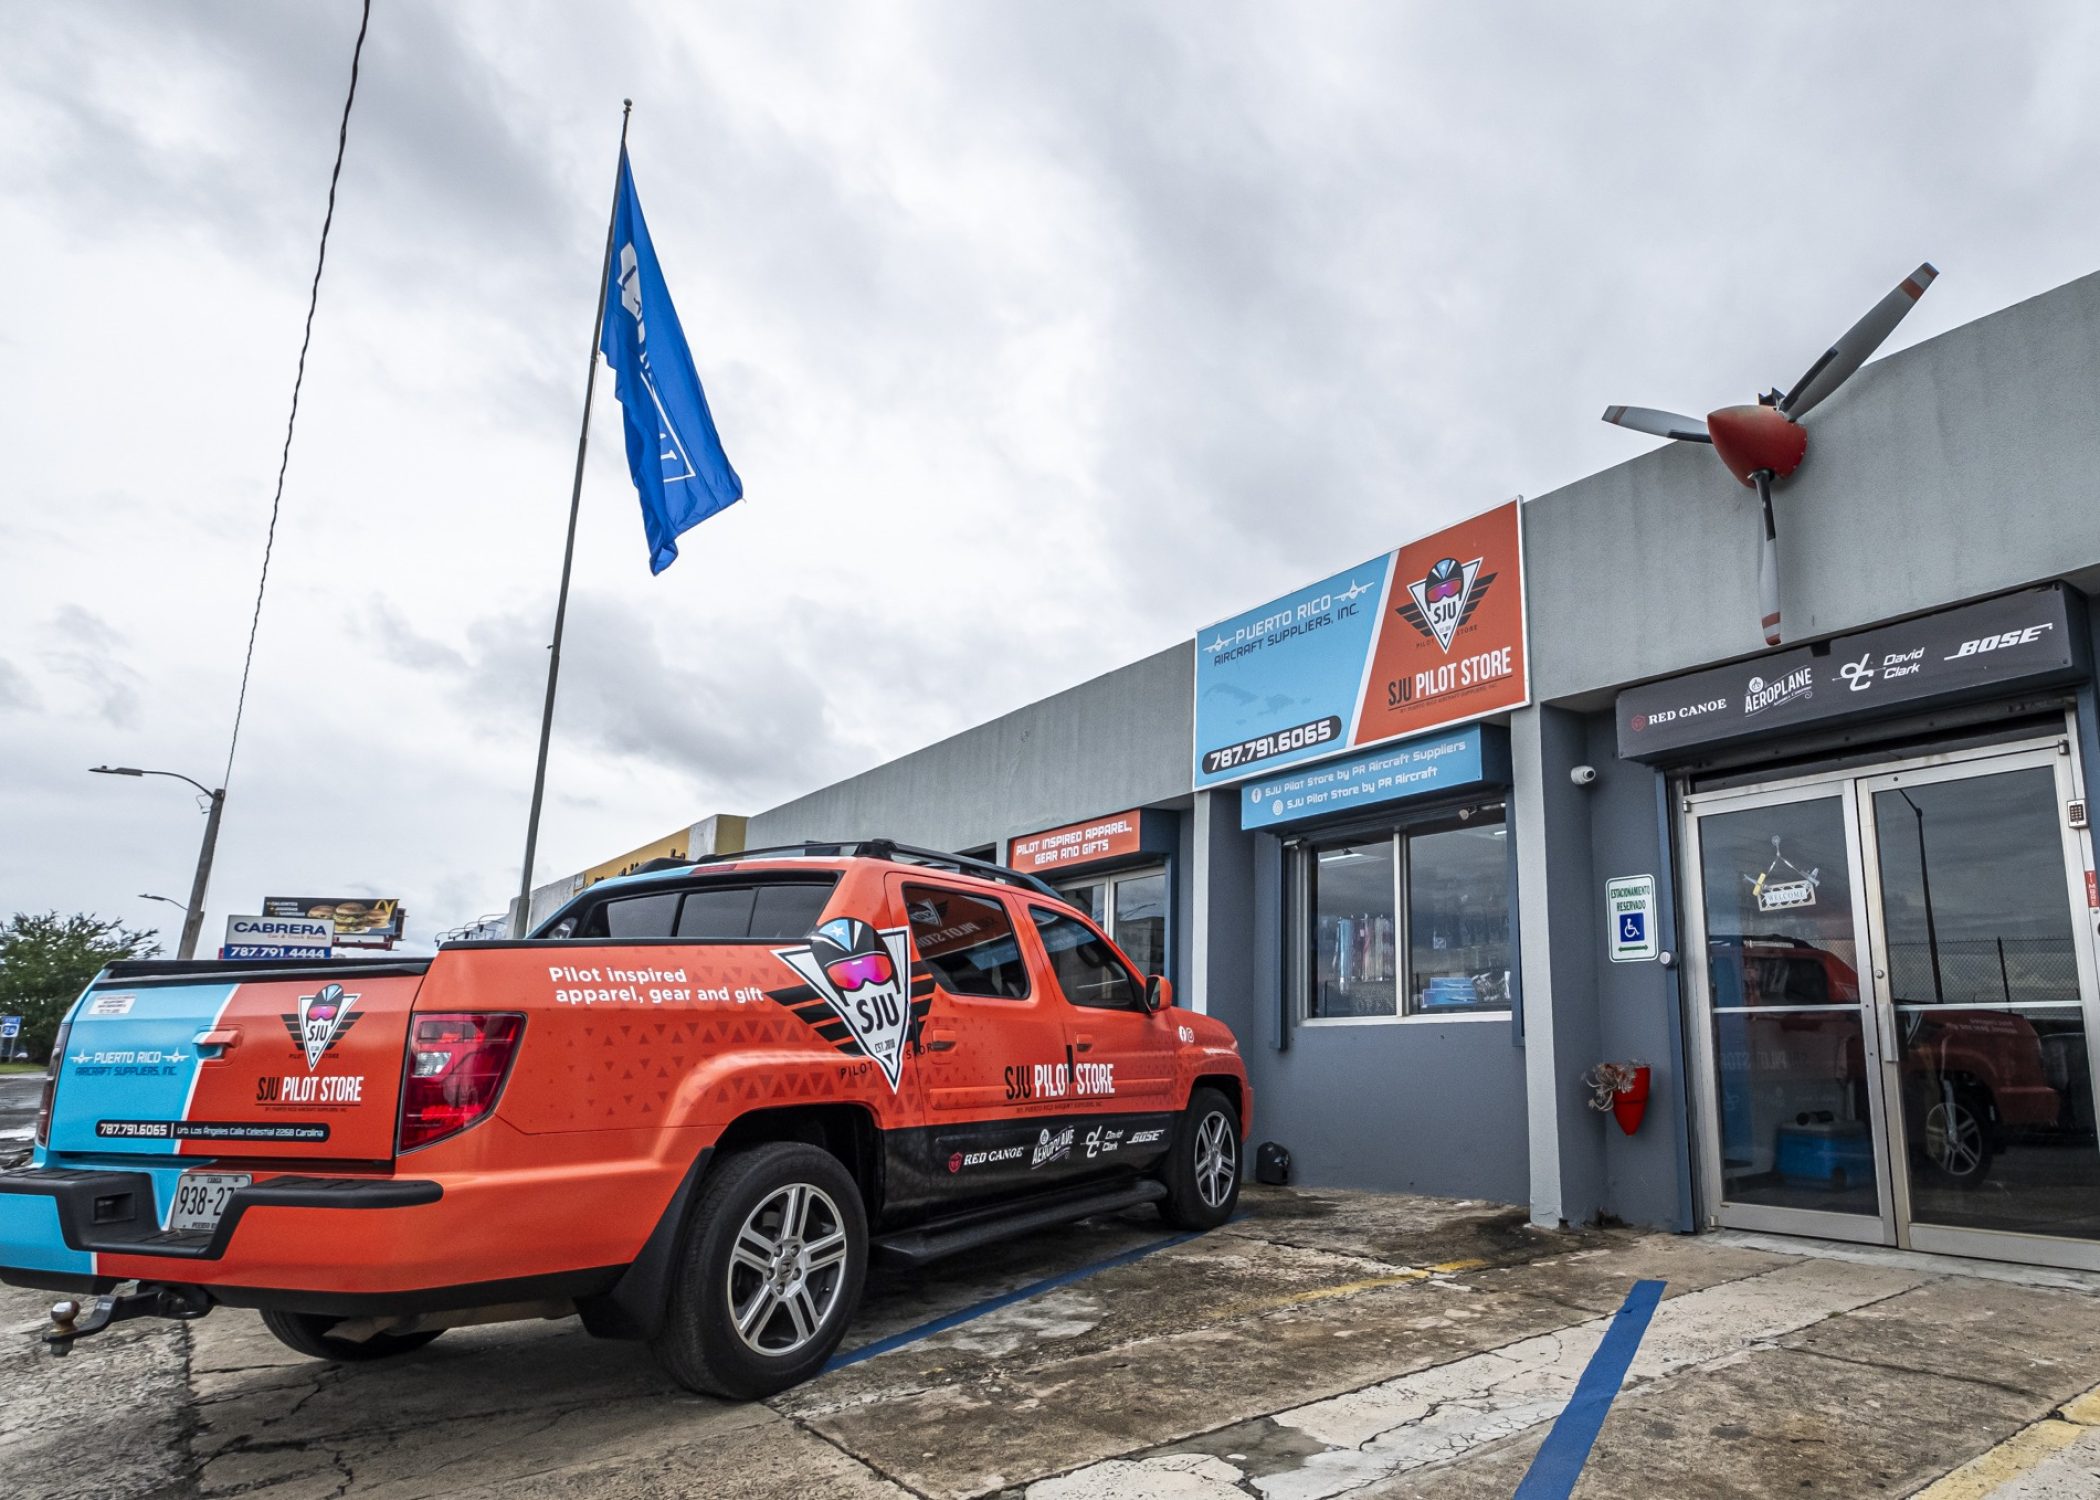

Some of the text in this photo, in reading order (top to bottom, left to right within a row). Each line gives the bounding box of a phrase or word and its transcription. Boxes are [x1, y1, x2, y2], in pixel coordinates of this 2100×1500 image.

[1235, 594, 1331, 644] PUERTO RICO
[1433, 601, 1457, 624] SJU
[1213, 638, 1264, 667] AIRCRAFT
[1267, 613, 1334, 647] SUPPLIERS,
[1950, 623, 2053, 659] BOSE
[1883, 647, 1925, 666] David
[1388, 646, 1512, 706] SJU PILOT STORE
[1883, 663, 1920, 679] Clark
[1744, 668, 1813, 714] AEROPLANE
[1649, 698, 1728, 725] RED CANOE
[1210, 720, 1331, 771] 787.791.6065
[1265, 741, 1466, 796] SJU Pilot Store by PR Aircraft Suppliers
[1287, 766, 1438, 810] SJU Pilot Store by PR Aircraft
[1016, 820, 1132, 856] PILOT INSPIRED APPAREL,
[1034, 839, 1109, 865] GEAR AND GIFTS
[1611, 885, 1650, 899] ESTACIONAMIENTO
[1767, 890, 1804, 901] WELCOME
[1617, 900, 1647, 912] RESERVADO
[234, 921, 326, 936] CABRERA
[549, 967, 687, 984] Pilot inspired
[556, 986, 765, 1004] apparel, gear and gift
[856, 993, 900, 1034] SJU
[308, 1025, 329, 1041] SJU
[94, 1051, 161, 1064] PUERTO RICO
[75, 1066, 112, 1076] AIRCRAFT
[840, 1061, 873, 1080] PILOT
[256, 1076, 364, 1102] SJU PILOT STORE
[1004, 1065, 1031, 1100] SJU
[1076, 1063, 1115, 1095] STORE
[100, 1123, 167, 1135] 787.791.6065
[295, 1128, 324, 1137] Carolina
[1105, 1130, 1123, 1140] David
[1128, 1129, 1166, 1143] BOSE
[964, 1147, 1024, 1165] RED CANOE
[1032, 1129, 1075, 1166] AEROPLANE
[1102, 1142, 1118, 1151] Clark
